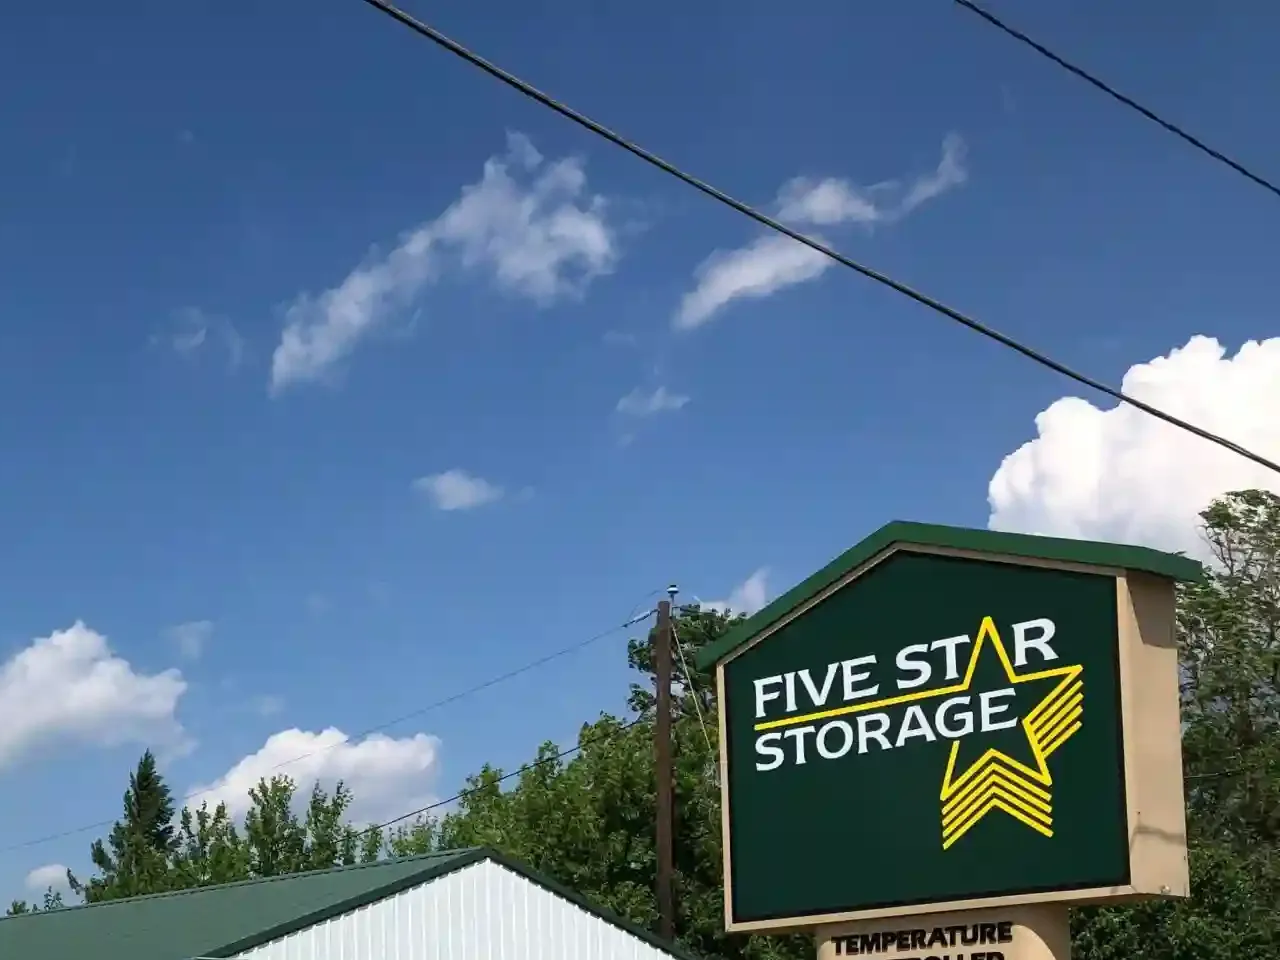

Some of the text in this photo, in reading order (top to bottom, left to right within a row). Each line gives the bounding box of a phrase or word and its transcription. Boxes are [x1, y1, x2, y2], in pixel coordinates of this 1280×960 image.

[753, 616, 1060, 718] FIVE STAR
[754, 687, 1018, 771] STORAGE
[831, 921, 1014, 956] TEMPERATURE
